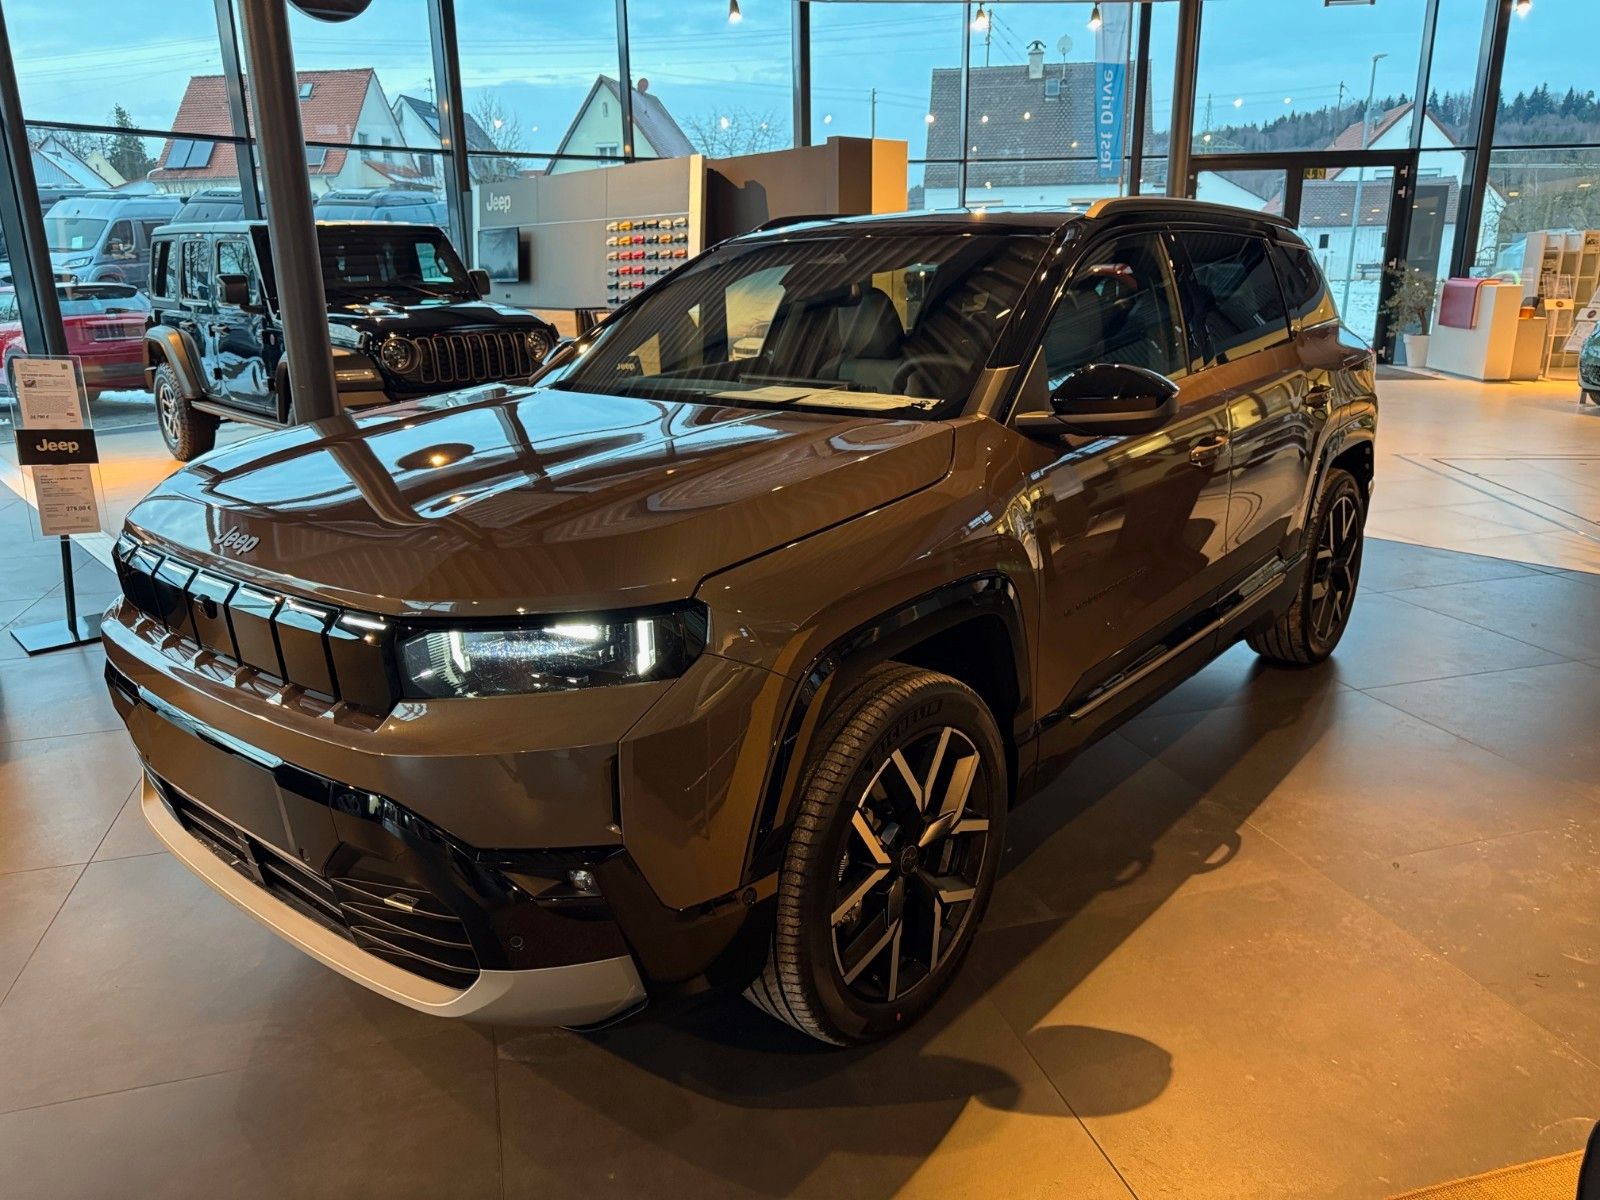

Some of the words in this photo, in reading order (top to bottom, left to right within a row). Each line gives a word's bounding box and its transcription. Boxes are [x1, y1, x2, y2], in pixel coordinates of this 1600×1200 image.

[486, 192, 511, 214] Jeep
[35, 438, 80, 454] Jeep
[213, 525, 260, 555] Jeep
